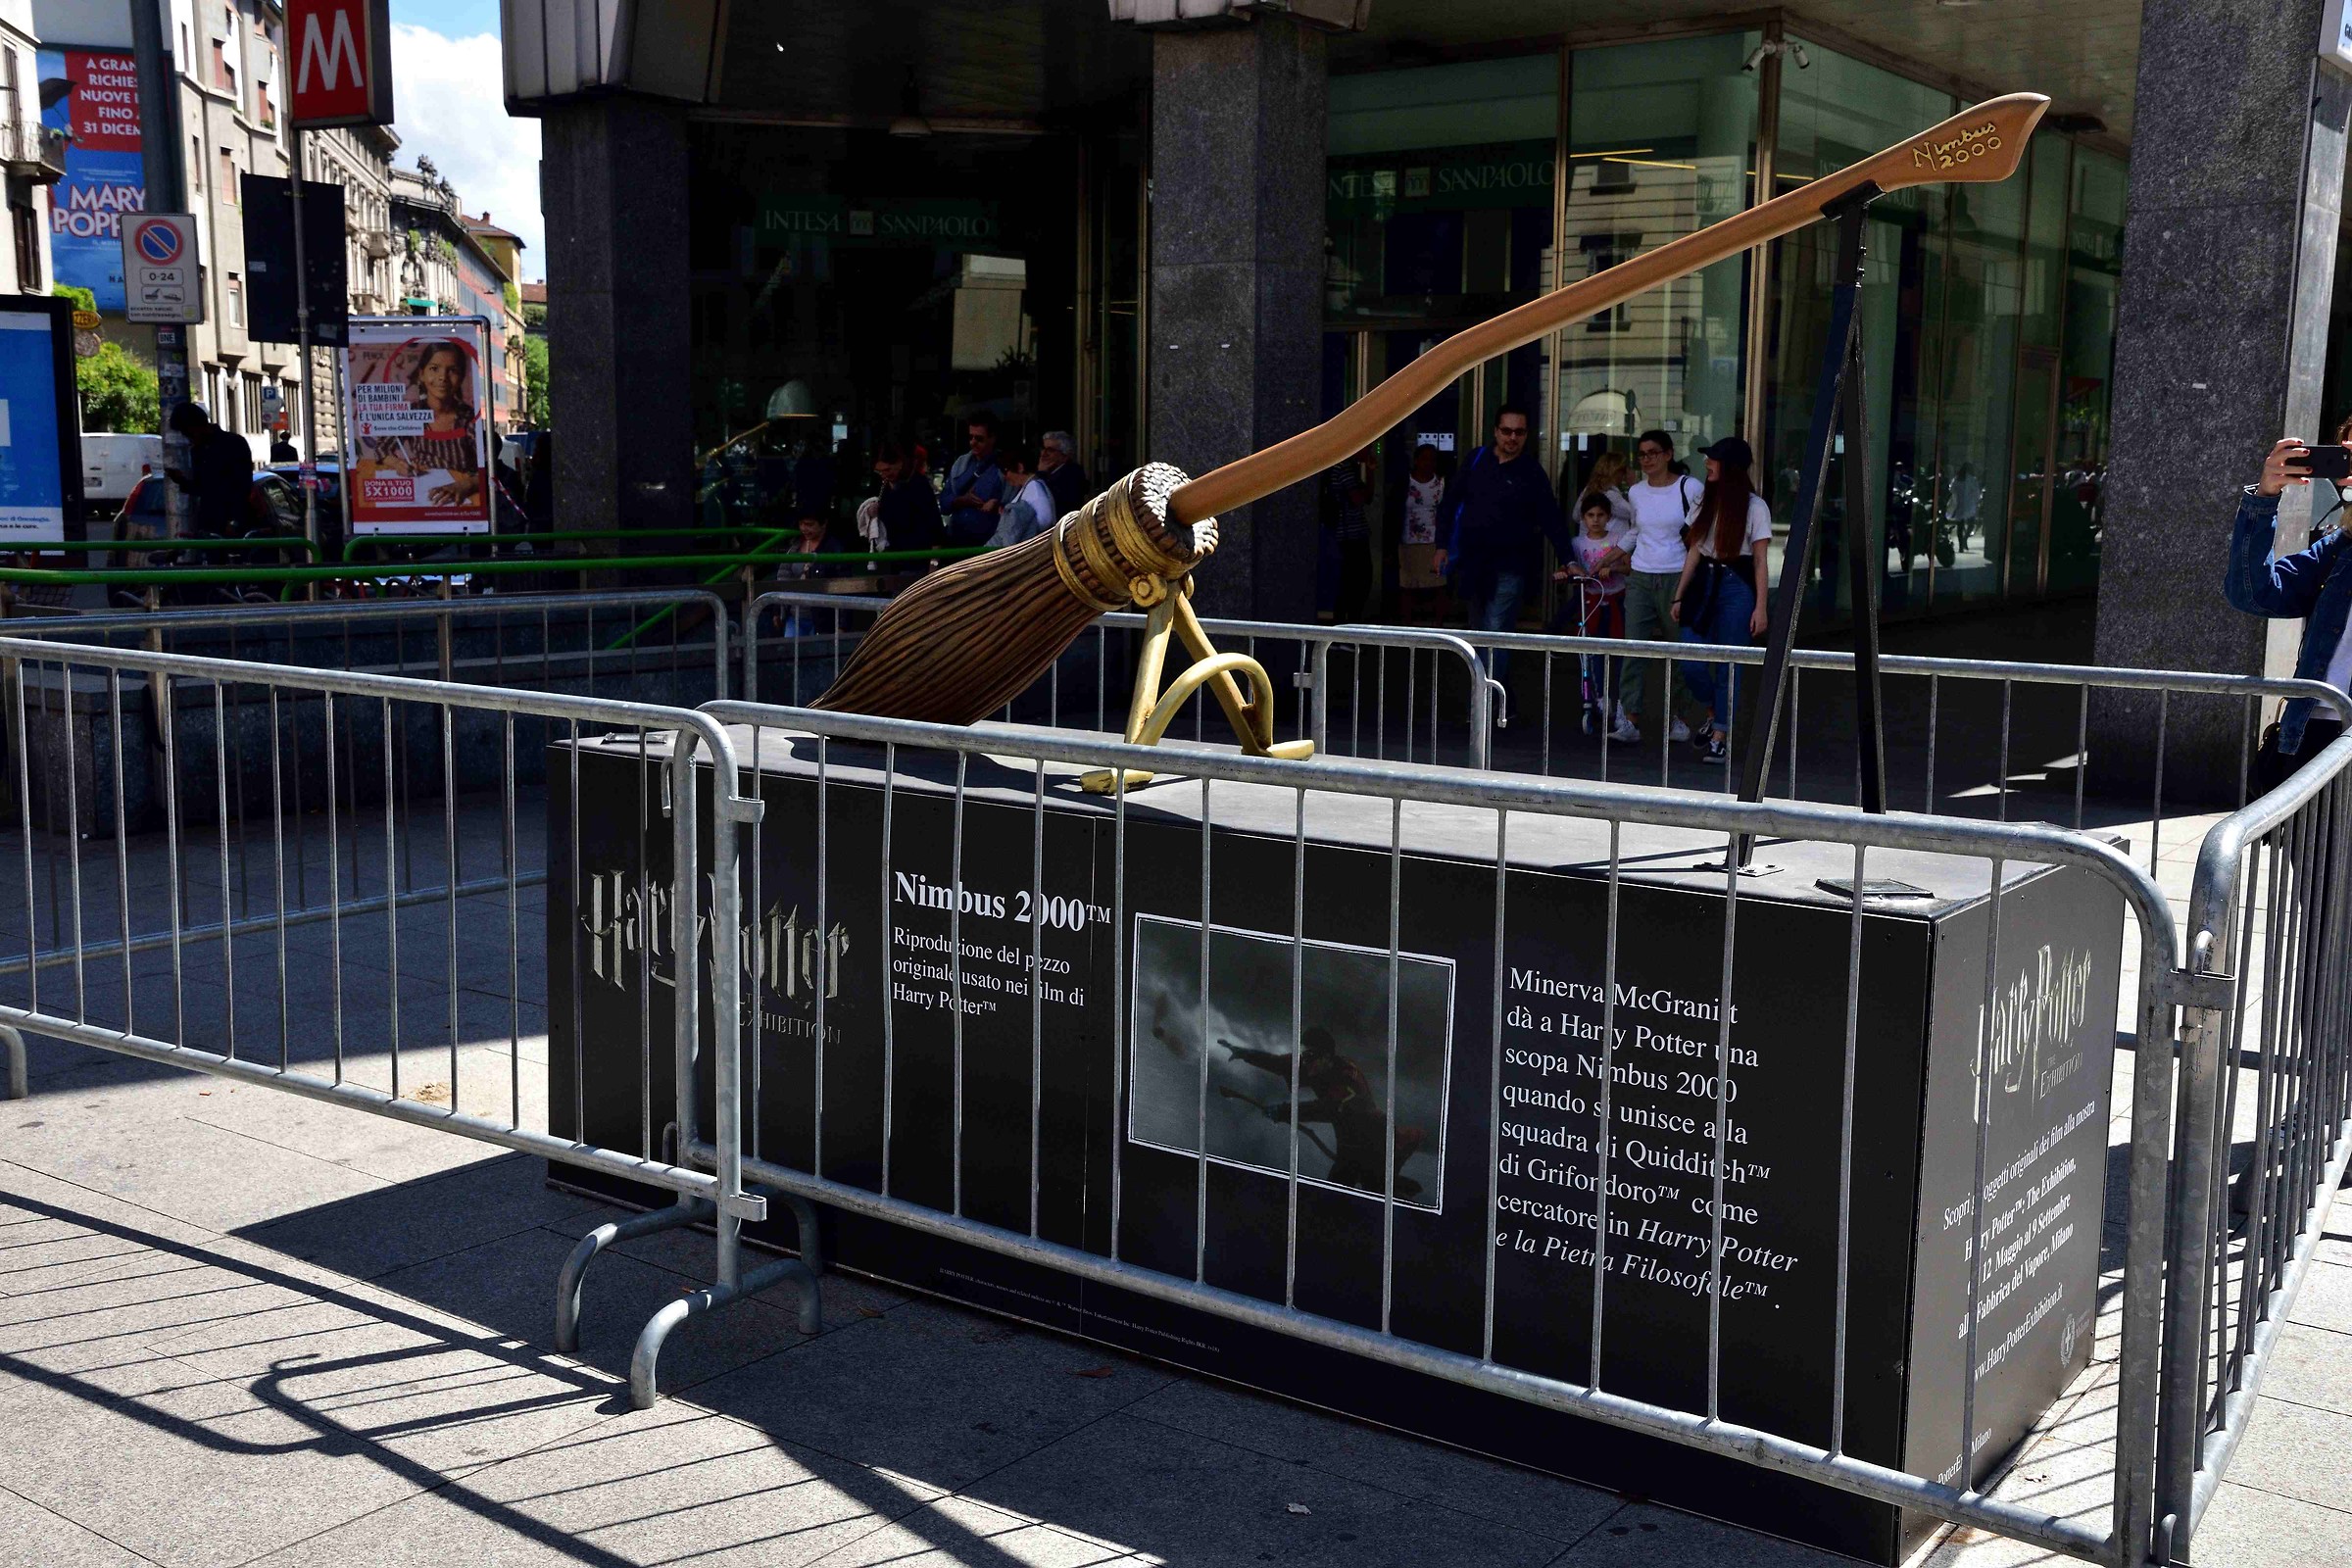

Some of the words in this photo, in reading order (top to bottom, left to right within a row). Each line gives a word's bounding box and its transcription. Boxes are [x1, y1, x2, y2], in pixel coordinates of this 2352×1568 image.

[86, 58, 97, 70] A
[100, 59, 136, 73] GRAN
[298, 9, 364, 94] M
[79, 89, 130, 104] NUOVE
[89, 74, 138, 88] RICHIES
[83, 122, 98, 133] 31
[101, 122, 141, 135] DICEM
[98, 107, 133, 120] FINO
[1912, 122, 1996, 172] Nimbus
[1939, 136, 2001, 170] 2000
[1438, 160, 1555, 192] SANPAOLO
[71, 184, 146, 212] MARY
[53, 208, 122, 238] POPP
[764, 209, 840, 232] INTESA
[881, 214, 990, 236] SANPAOLO
[149, 272, 175, 281] 0-24
[358, 394, 367, 403] DI
[397, 413, 433, 421] SALVEZZA
[366, 486, 413, 497] 5X1000
[895, 871, 1005, 919] Nimbus
[997, 946, 1020, 965] del
[893, 982, 934, 1010] Harry
[962, 971, 1001, 991] usato
[1005, 978, 1028, 997] nei
[1036, 980, 1064, 1004] ilm
[1071, 987, 1085, 1007] di
[1509, 966, 1604, 1004] Minerva
[1613, 983, 1739, 1024] McGranit
[739, 1002, 841, 1045] XHIBITION
[1506, 1005, 1533, 1030] dà
[1540, 1015, 1553, 1033] a
[1560, 1012, 1627, 1051] Hary
[1635, 1025, 1707, 1058] Potter
[1505, 1047, 1569, 1076] scopa
[1576, 1054, 1668, 1091] Nimbus
[1676, 1070, 1738, 1102] 2000
[1502, 1084, 1586, 1114] quando
[1619, 1103, 1695, 1135] unisce
[1703, 1118, 1748, 1145] ala
[1501, 1120, 1589, 1153] squadra
[1943, 1193, 1970, 1231] Scopri
[1984, 1163, 2009, 1202] oggetti
[2010, 1141, 2038, 1178] originali
[2039, 1131, 2050, 1154] dei
[2050, 1126, 2064, 1147] film
[2064, 1112, 2076, 1136] alla
[2076, 1101, 2095, 1127] mostra
[1498, 1153, 1520, 1176] di
[1691, 1197, 1759, 1225] come
[1964, 1228, 1990, 1262] Hry
[2026, 1183, 2040, 1210] The
[2040, 1157, 2077, 1200] Exhibition,
[1495, 1232, 1507, 1247] e
[1514, 1229, 1536, 1253] la
[1543, 1236, 1614, 1271] Pietra
[1497, 1195, 1598, 1230] cercatore
[1608, 1211, 1630, 1237] in
[1637, 1218, 1712, 1259] Harry
[1720, 1236, 1798, 1272] Potter
[1982, 1257, 1992, 1284] 12
[1994, 1233, 2024, 1272] Maggio
[2024, 1227, 2032, 1249] al
[2032, 1222, 2037, 1240] 9
[2037, 1193, 2071, 1235] Settembre
[1958, 1312, 1970, 1340] all
[1977, 1282, 2010, 1323] Fabbrica
[2011, 1263, 2024, 1290] del
[2024, 1246, 2050, 1279] Vapore,
[2050, 1223, 2074, 1255] Milano
